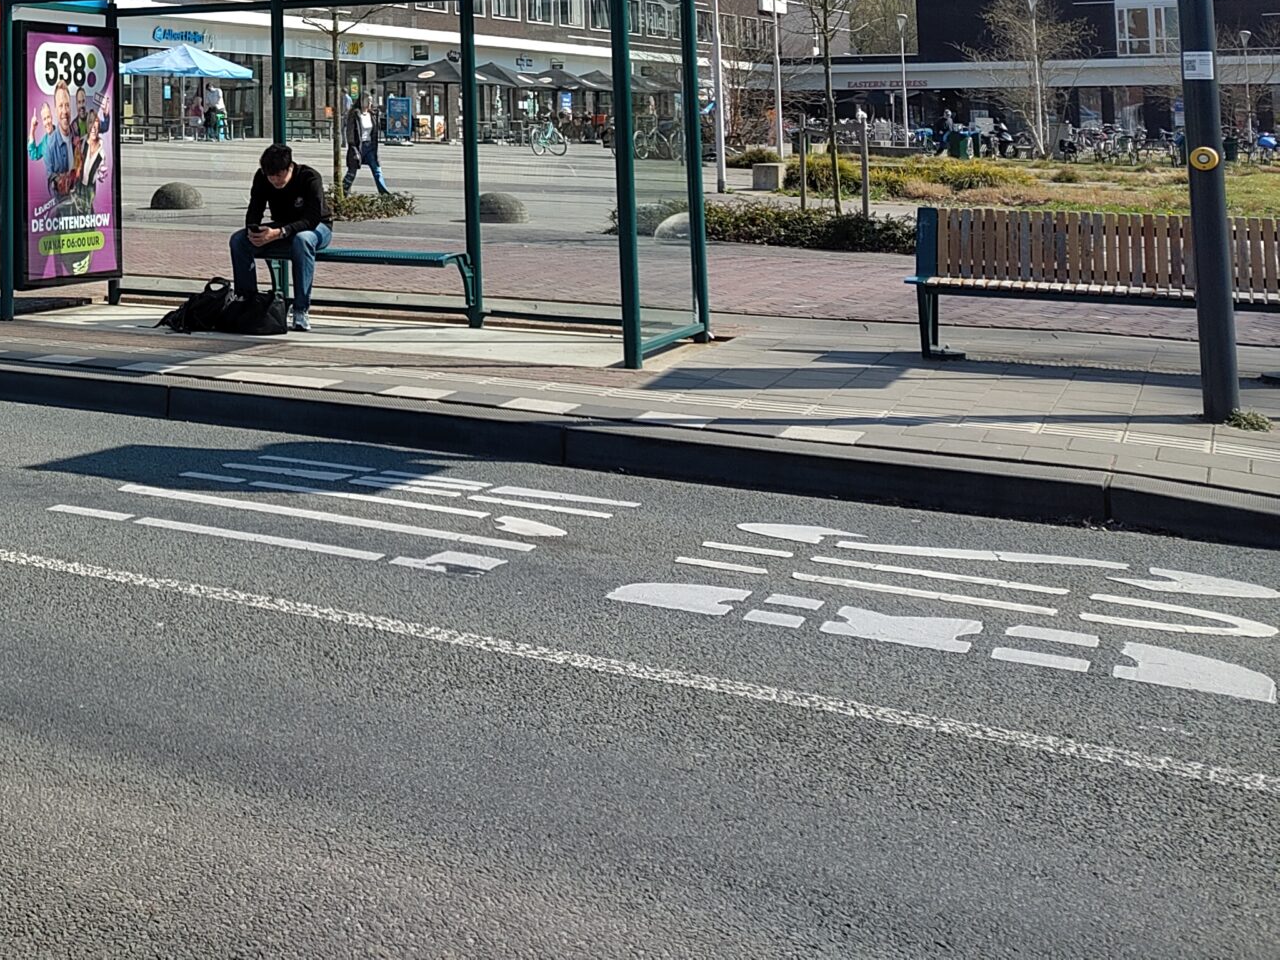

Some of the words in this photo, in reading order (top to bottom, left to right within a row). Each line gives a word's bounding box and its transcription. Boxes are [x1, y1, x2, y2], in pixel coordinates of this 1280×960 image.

[44, 50, 86, 87] 538
[847, 80, 887, 88] EASTERN
[889, 79, 929, 88] EXPRESS
[31, 218, 44, 233] DE
[45, 213, 111, 232] OCHTENDSHOW
[43, 238, 66, 251] VANAF
[66, 237, 86, 249] 06:00
[87, 236, 100, 246] UUR
[605, 521, 1280, 704] BUS
